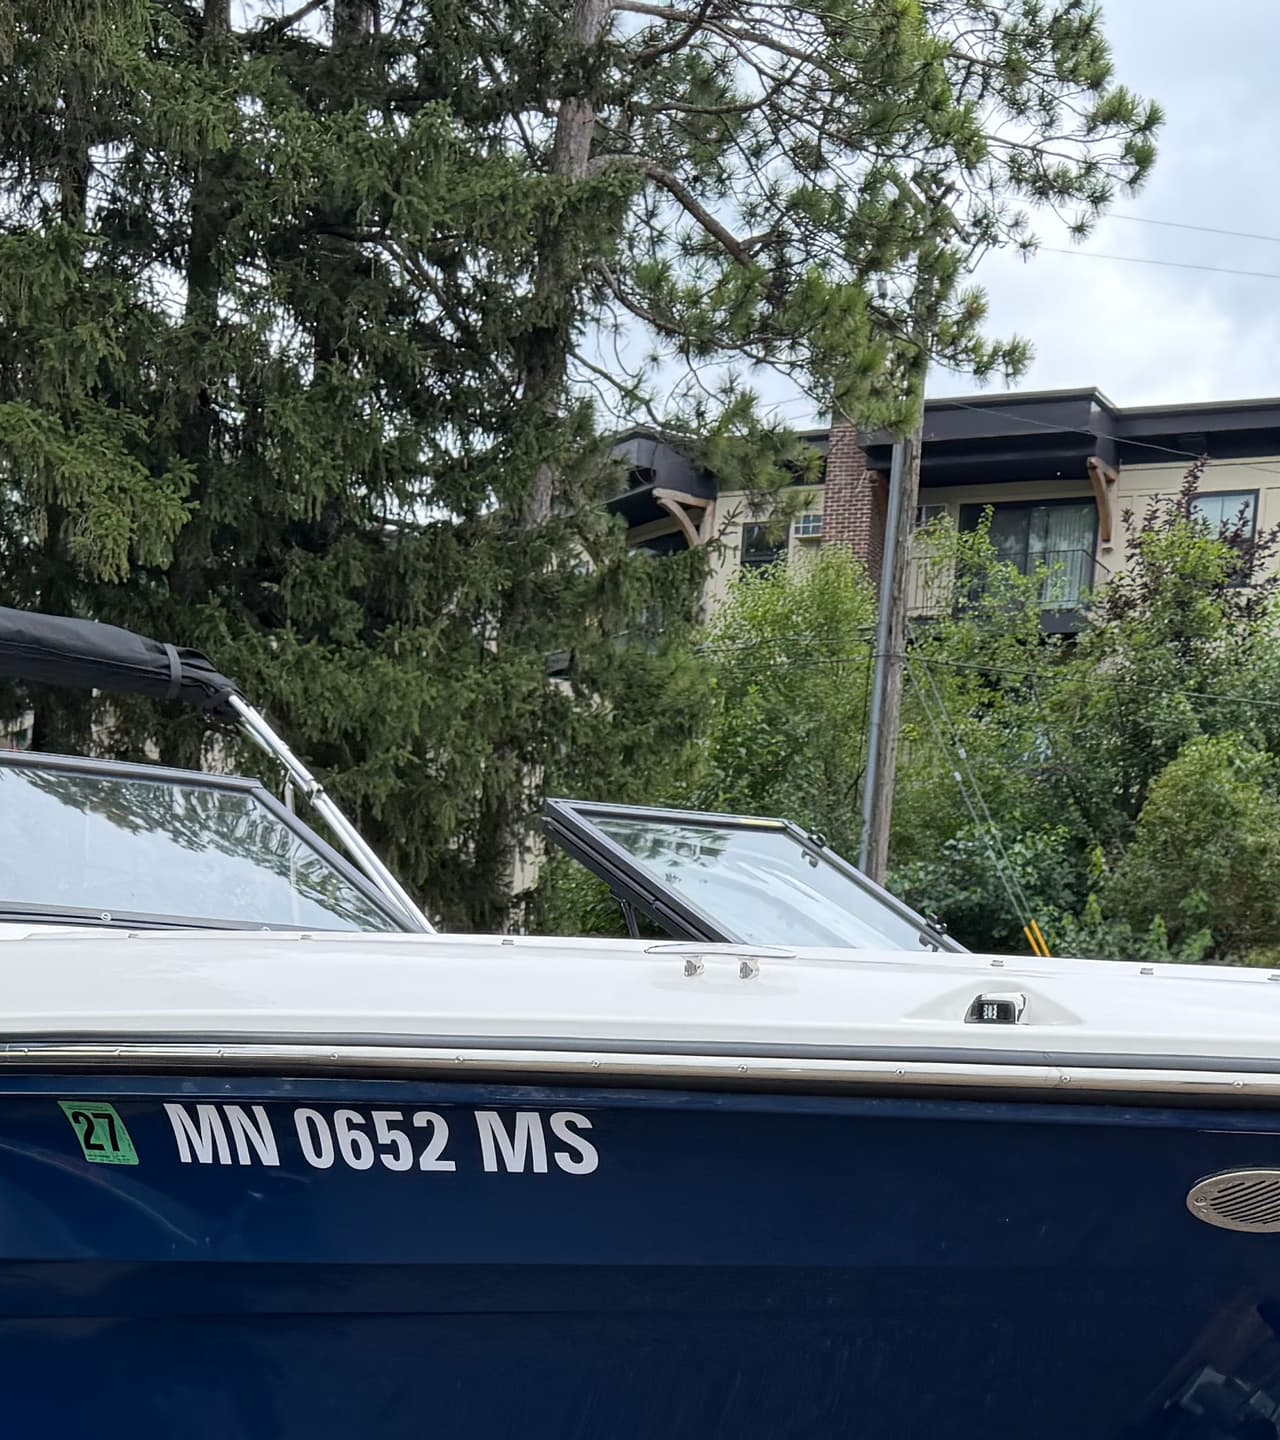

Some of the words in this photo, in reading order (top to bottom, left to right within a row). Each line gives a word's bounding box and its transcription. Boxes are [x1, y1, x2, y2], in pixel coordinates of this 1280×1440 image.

[71, 1111, 120, 1152] 27
[163, 1103, 280, 1166] MN
[294, 1107, 456, 1171] 0652
[474, 1110, 599, 1175] MS
